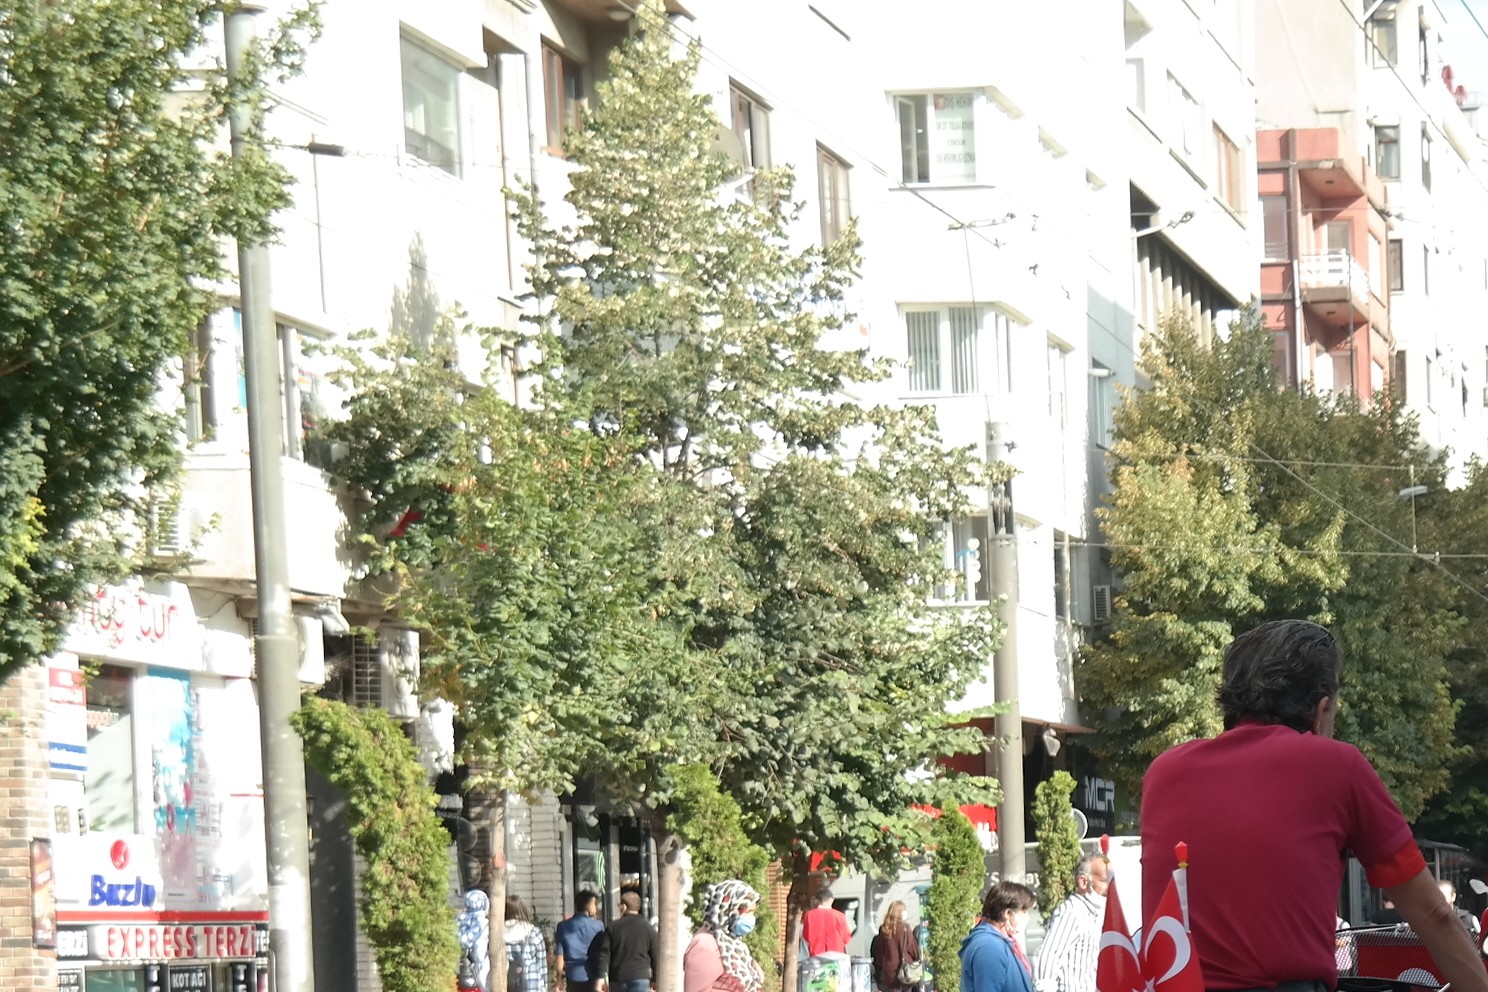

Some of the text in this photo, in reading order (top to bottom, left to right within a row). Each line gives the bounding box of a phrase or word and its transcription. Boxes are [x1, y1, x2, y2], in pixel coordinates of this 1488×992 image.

[1085, 776, 1115, 812] MCR
[107, 926, 197, 958] EXPRESS
[172, 974, 189, 988] KOT
